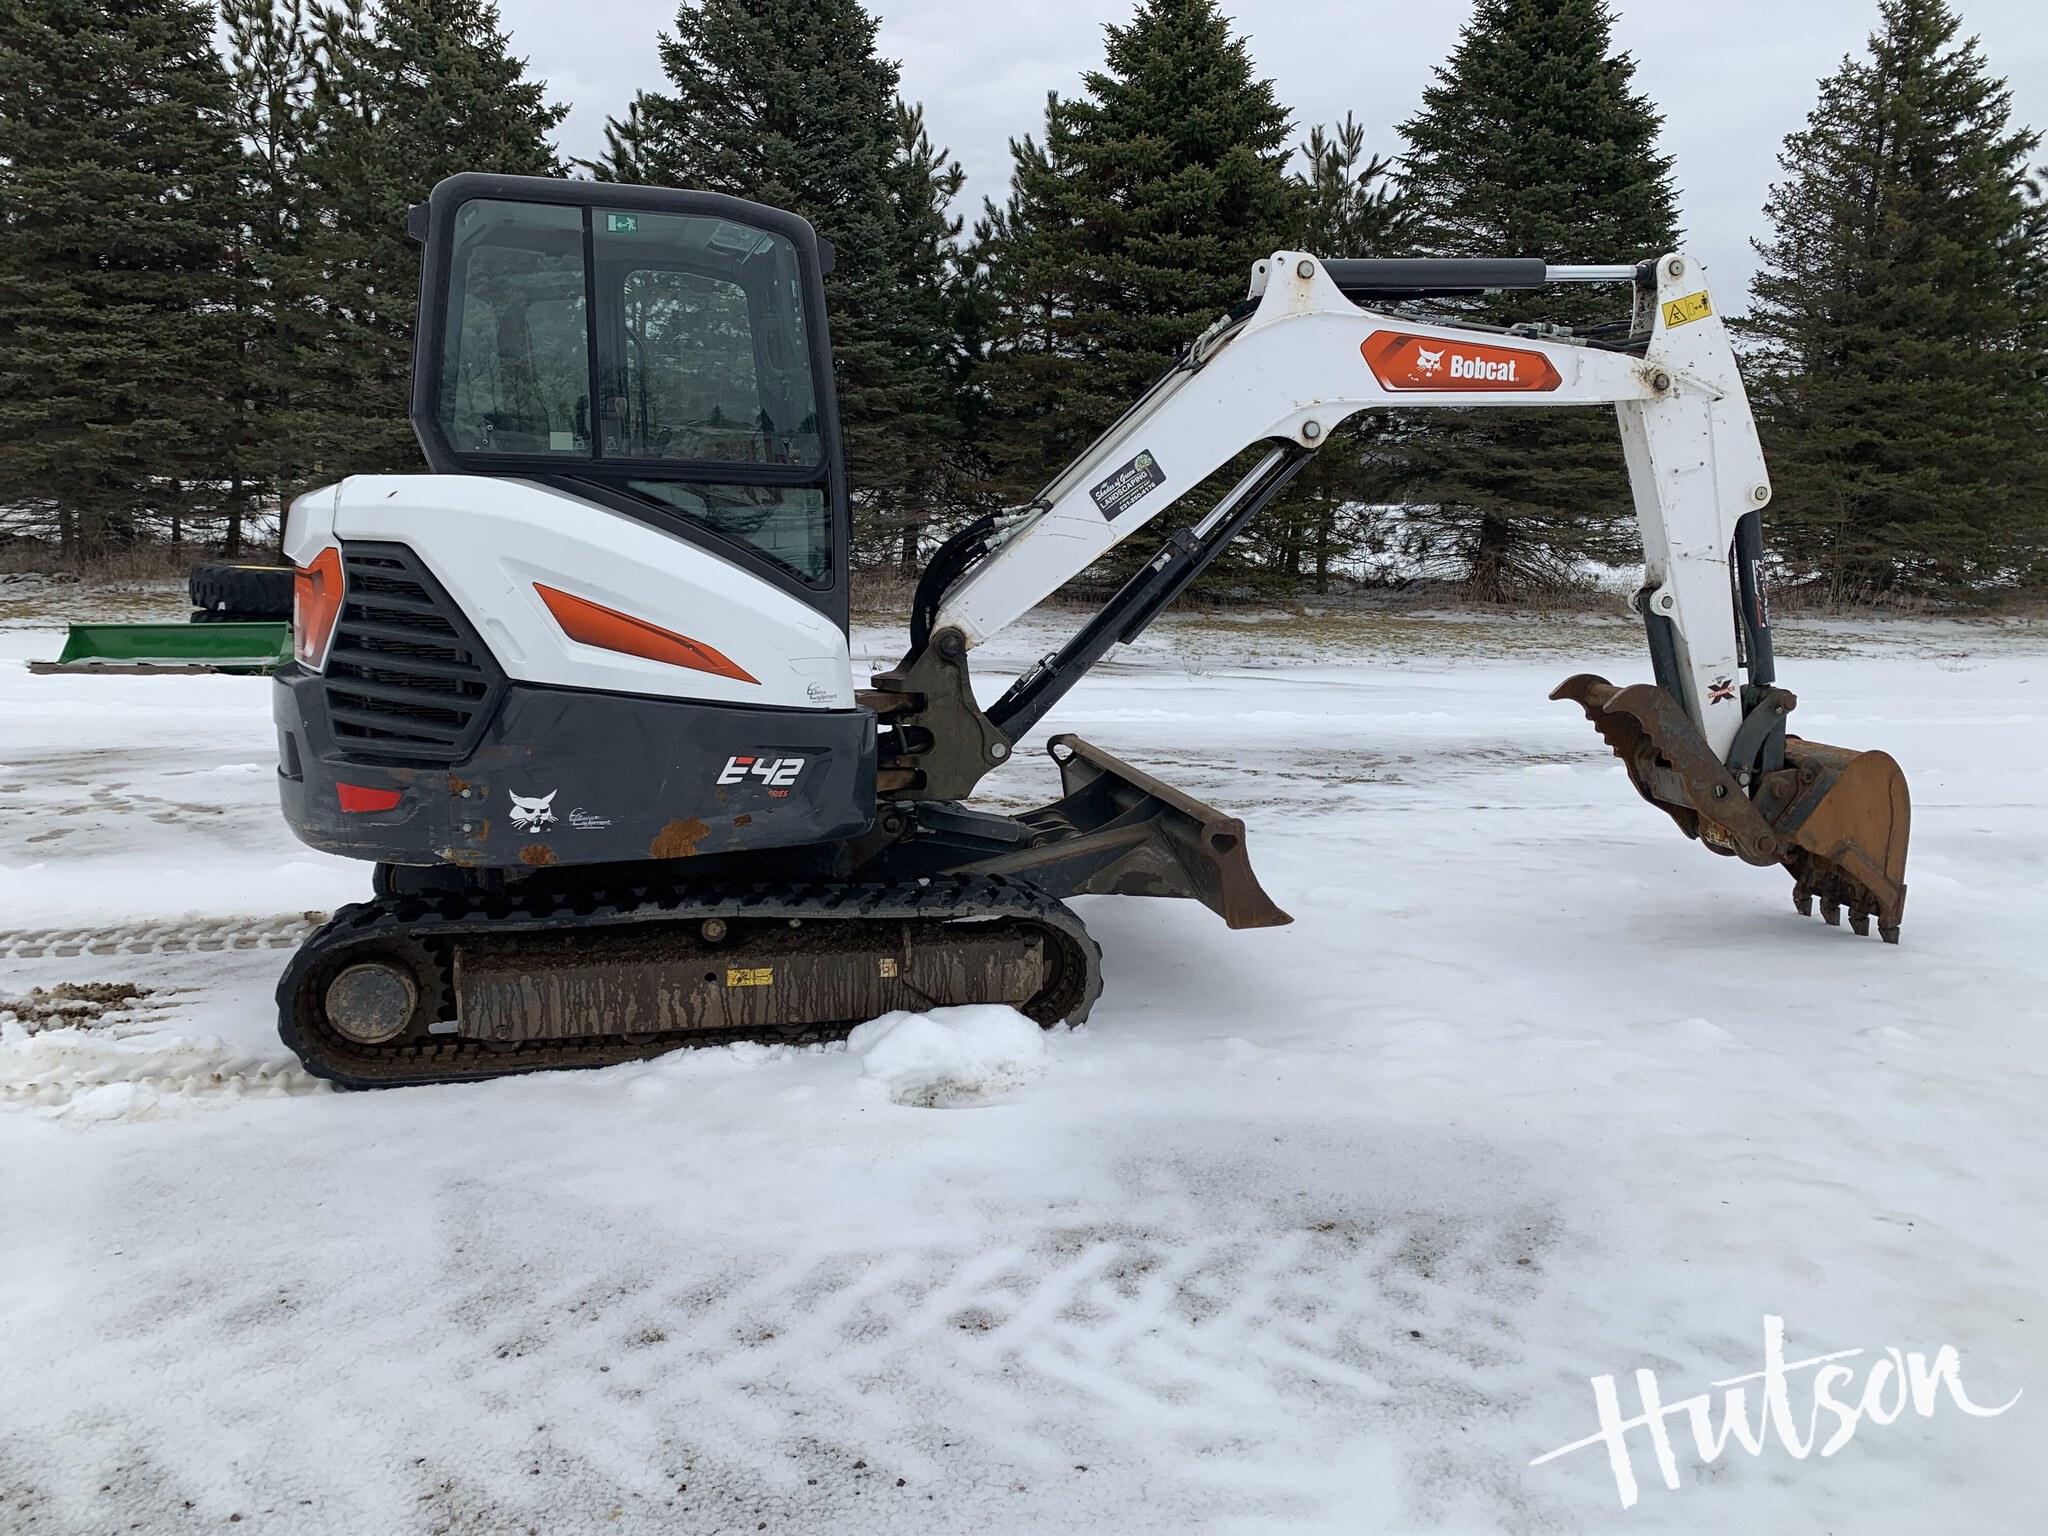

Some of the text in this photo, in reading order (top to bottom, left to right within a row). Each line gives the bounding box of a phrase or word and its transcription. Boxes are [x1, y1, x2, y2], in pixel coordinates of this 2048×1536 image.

[1450, 355, 1516, 381] Bobcat
[1100, 471, 1148, 509] LANDSCAPING
[716, 756, 805, 785] E42
